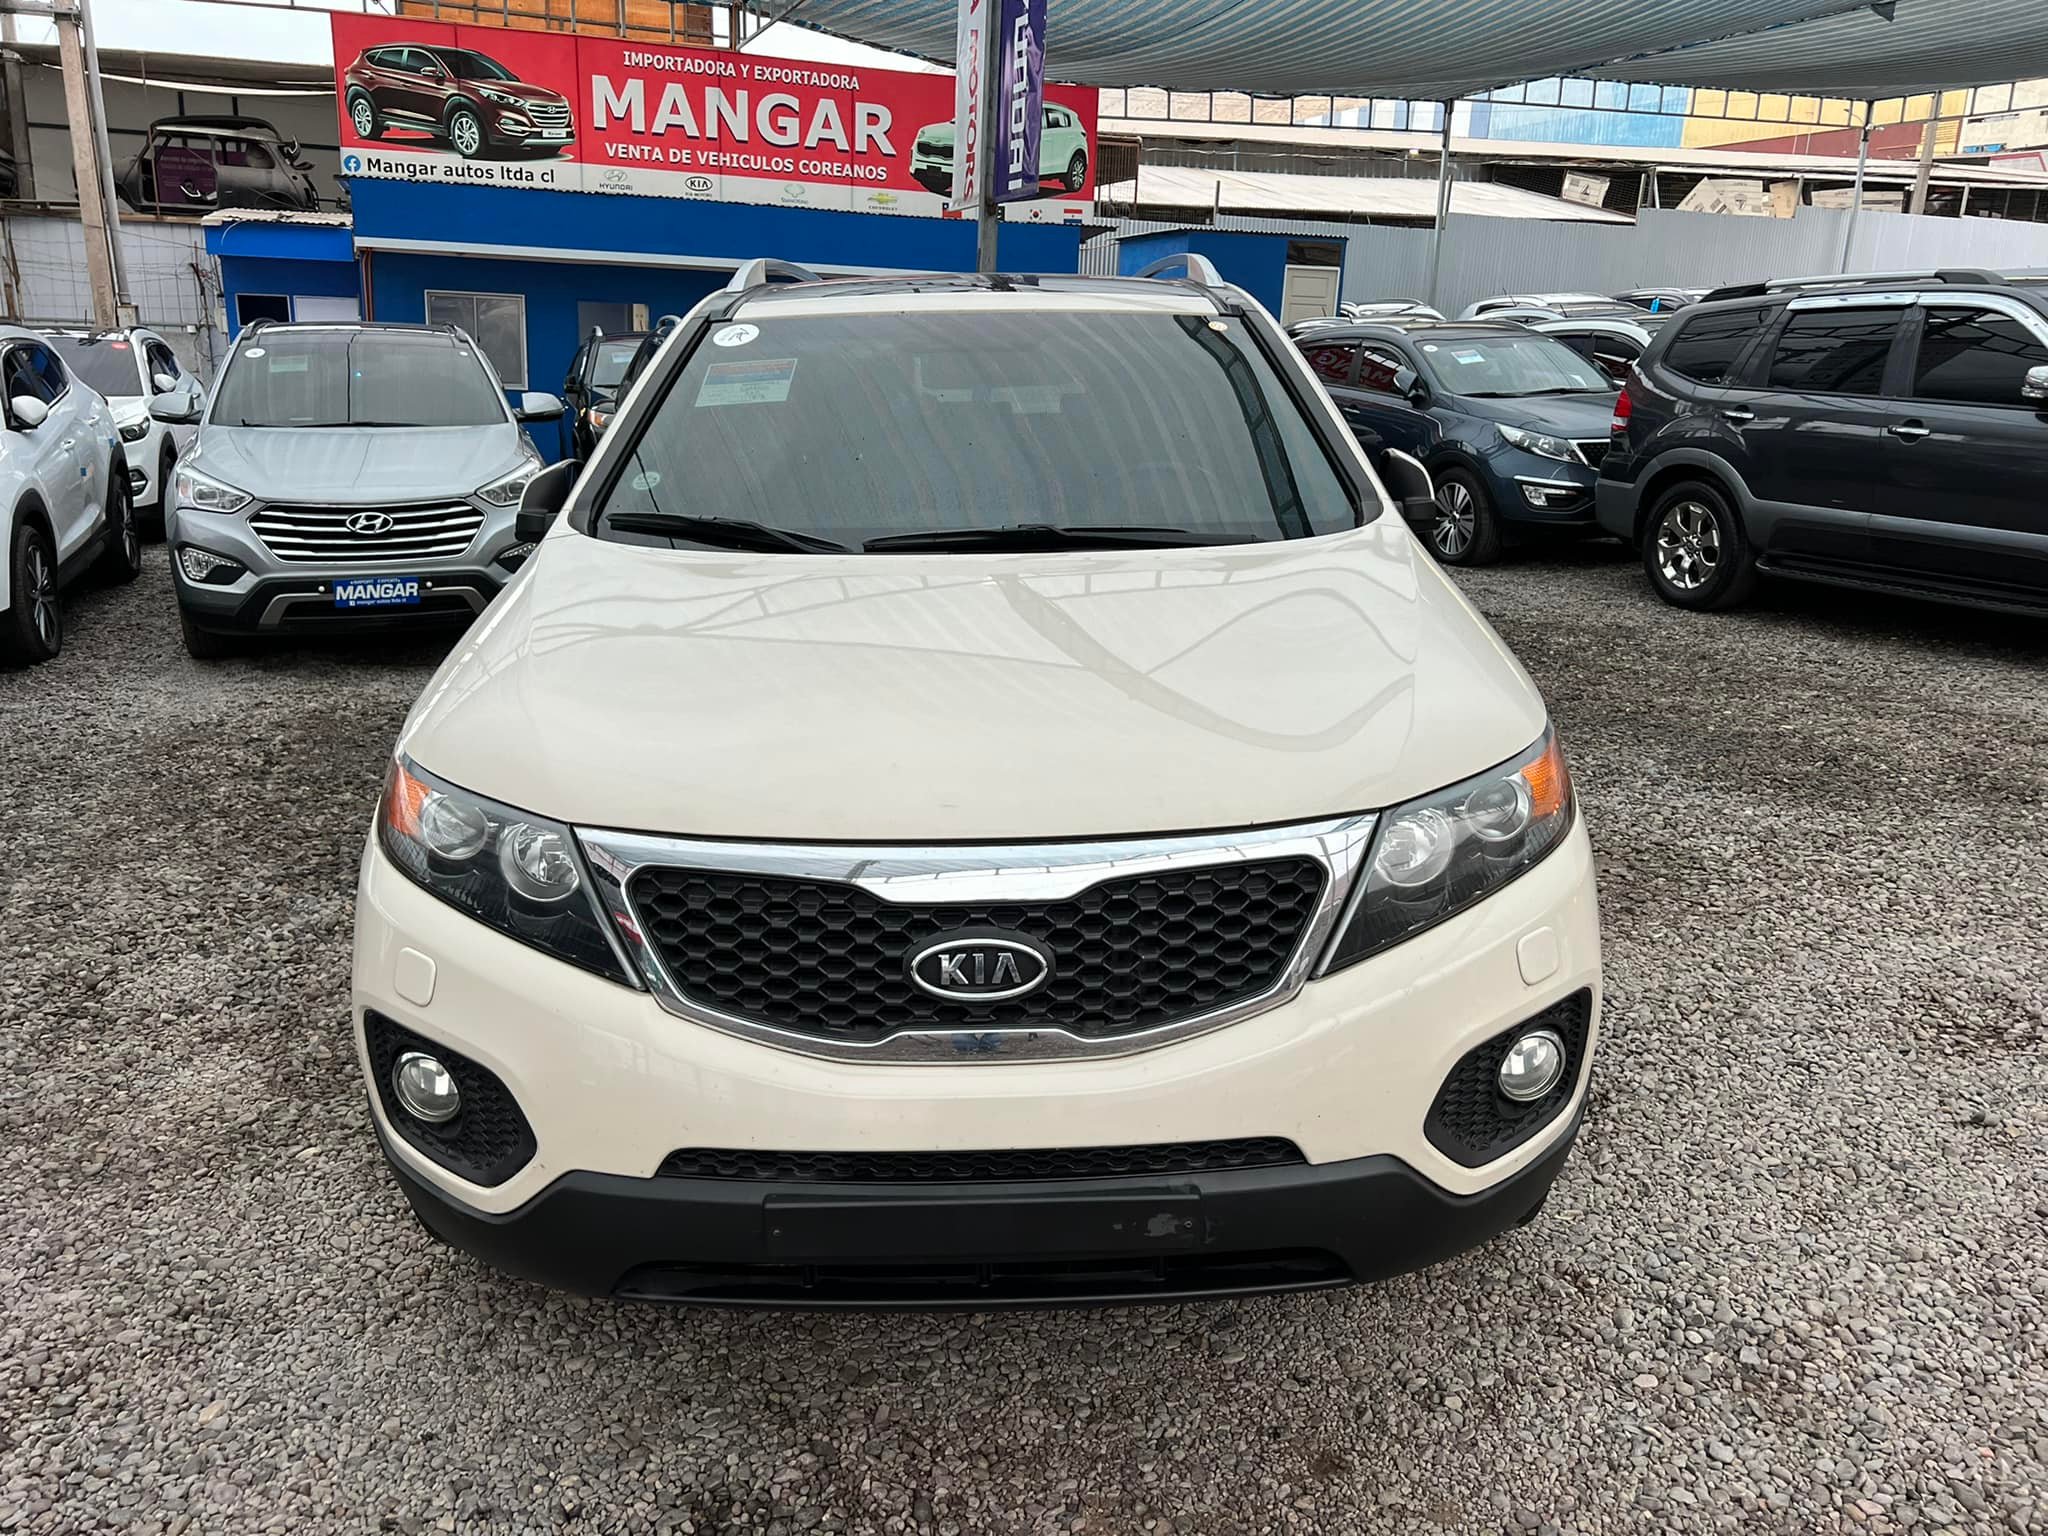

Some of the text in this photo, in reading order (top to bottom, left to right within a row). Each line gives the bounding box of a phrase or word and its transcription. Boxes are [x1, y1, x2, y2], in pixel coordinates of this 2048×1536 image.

[623, 51, 860, 91] IMPORTADORA Y EXPORTADORA
[591, 75, 897, 156] MANGAR
[963, 29, 979, 200] MOTORS
[366, 157, 555, 184] Mangar autos ltda cl
[605, 142, 888, 181] VENTA DE VEHICULOS COREANOS
[690, 178, 710, 189] KIA
[335, 582, 419, 601] MANGAR
[938, 952, 1023, 985] KIA
